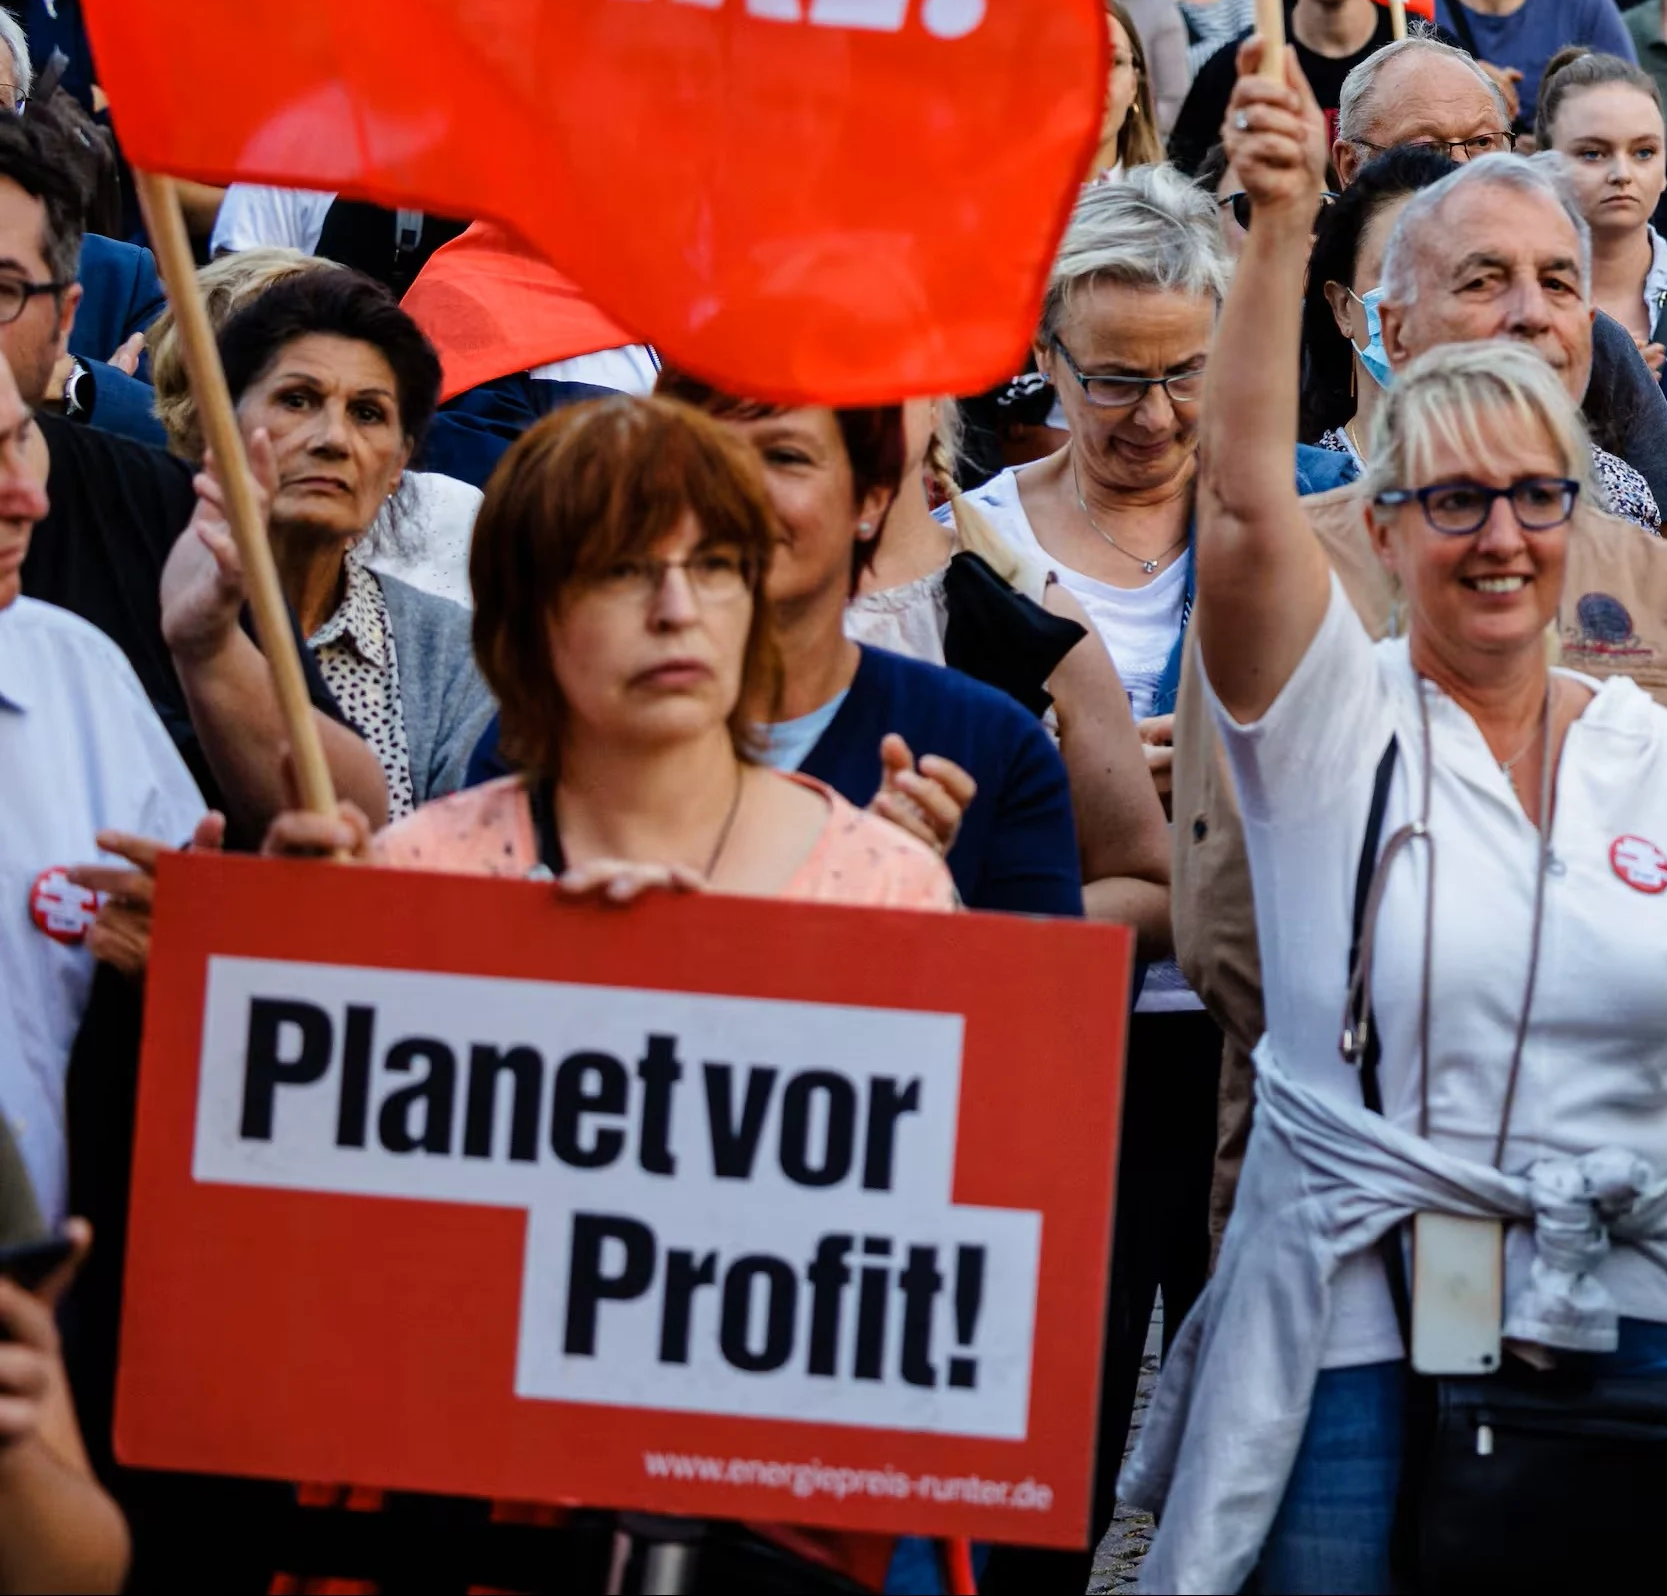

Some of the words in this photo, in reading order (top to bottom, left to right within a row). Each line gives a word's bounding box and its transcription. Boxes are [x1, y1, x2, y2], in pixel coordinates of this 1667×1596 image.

[238, 996, 682, 1176] Planet
[704, 1062, 921, 1192] vor
[562, 1209, 987, 1390] Profit!
[642, 1451, 1055, 1511] www.energiepreis-runter.de
